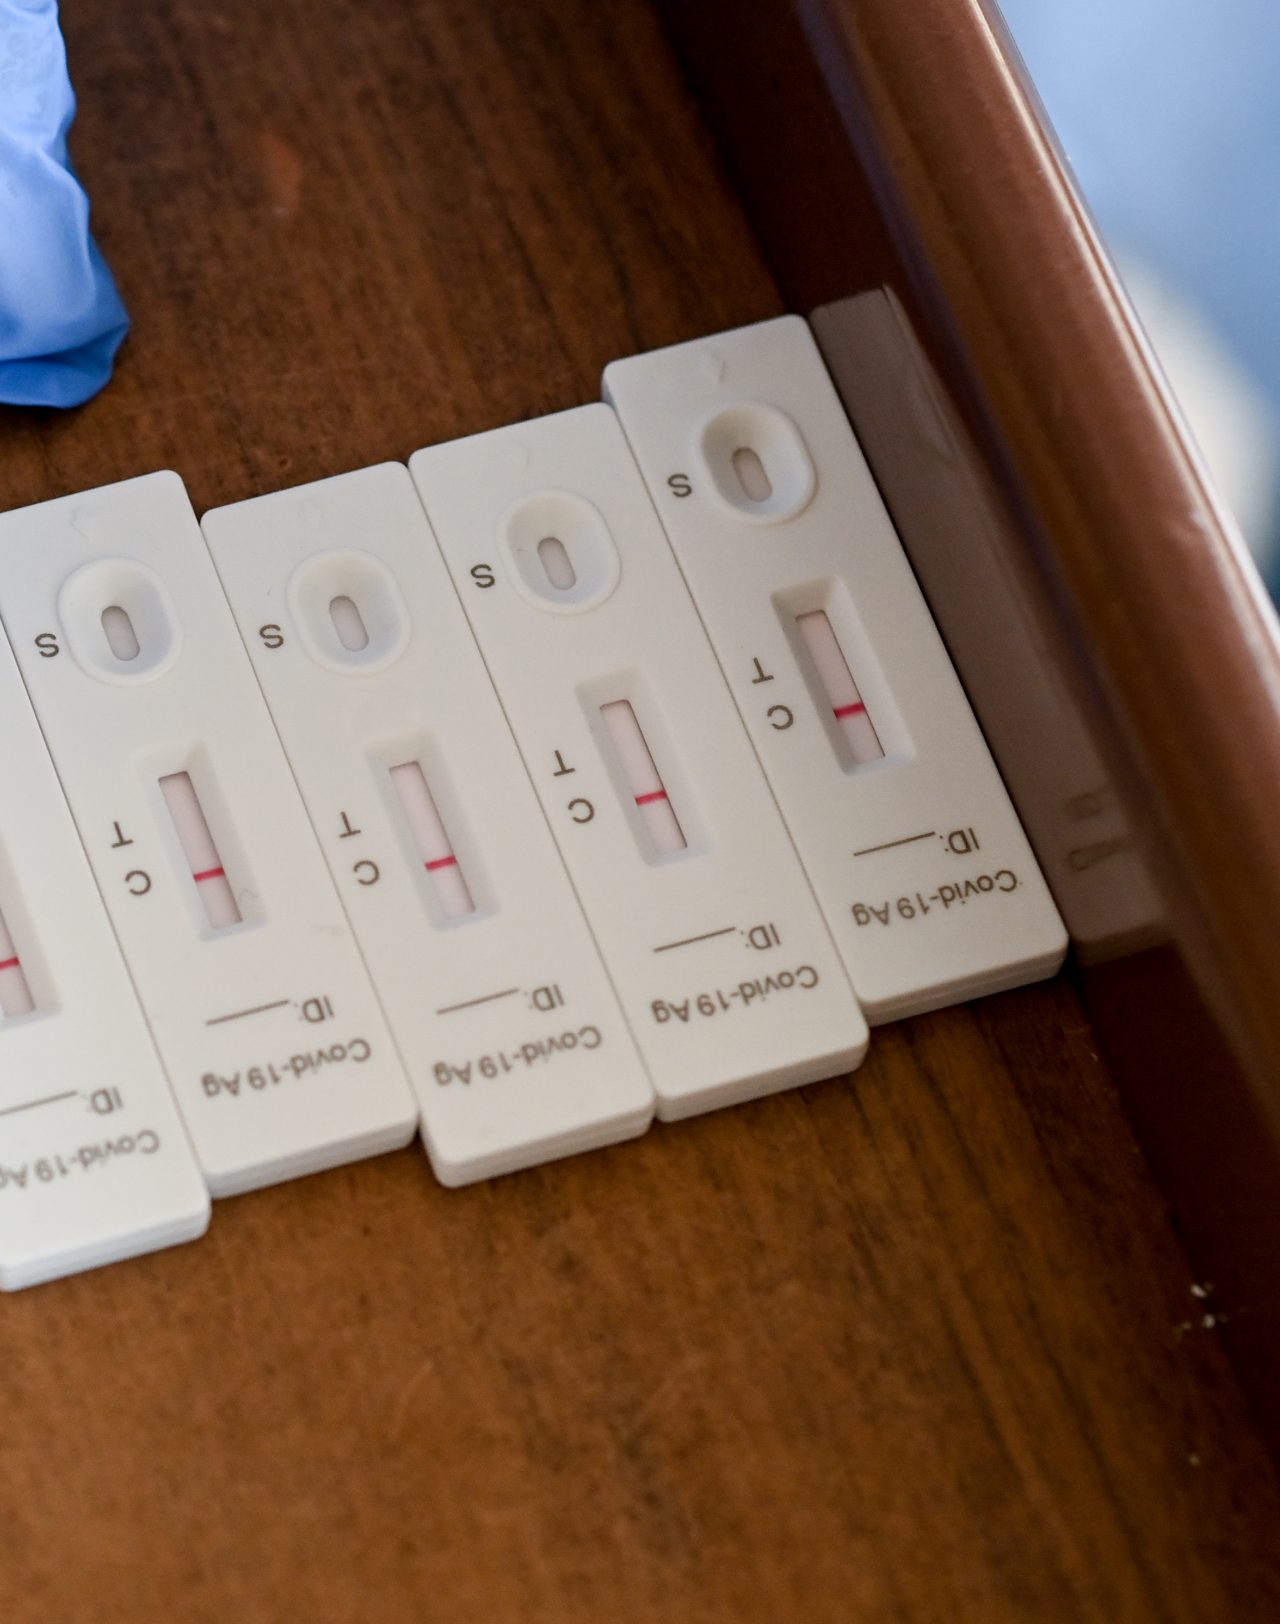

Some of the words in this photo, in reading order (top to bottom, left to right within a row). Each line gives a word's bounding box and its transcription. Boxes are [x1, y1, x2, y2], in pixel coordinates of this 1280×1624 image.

[667, 473, 693, 499] S
[470, 564, 496, 589] S
[34, 633, 60, 658] S
[259, 624, 284, 649] S
[752, 657, 774, 684] T
[767, 705, 794, 730] C
[553, 750, 576, 777] T
[567, 798, 595, 824] C
[111, 821, 134, 849] T
[339, 811, 361, 839] T
[938, 827, 980, 855] ID:
[125, 870, 152, 896] C
[353, 860, 380, 886] C
[896, 870, 1019, 919] Covid-19
[851, 902, 890, 926] Ag
[696, 965, 819, 1017] Covid-19
[650, 999, 689, 1024] Ag
[247, 1038, 371, 1090] Covid-19
[478, 1026, 602, 1079] Covid-19
[201, 1073, 240, 1097] Ag
[432, 1062, 471, 1086] Ag
[35, 1130, 160, 1182] Covid-19
